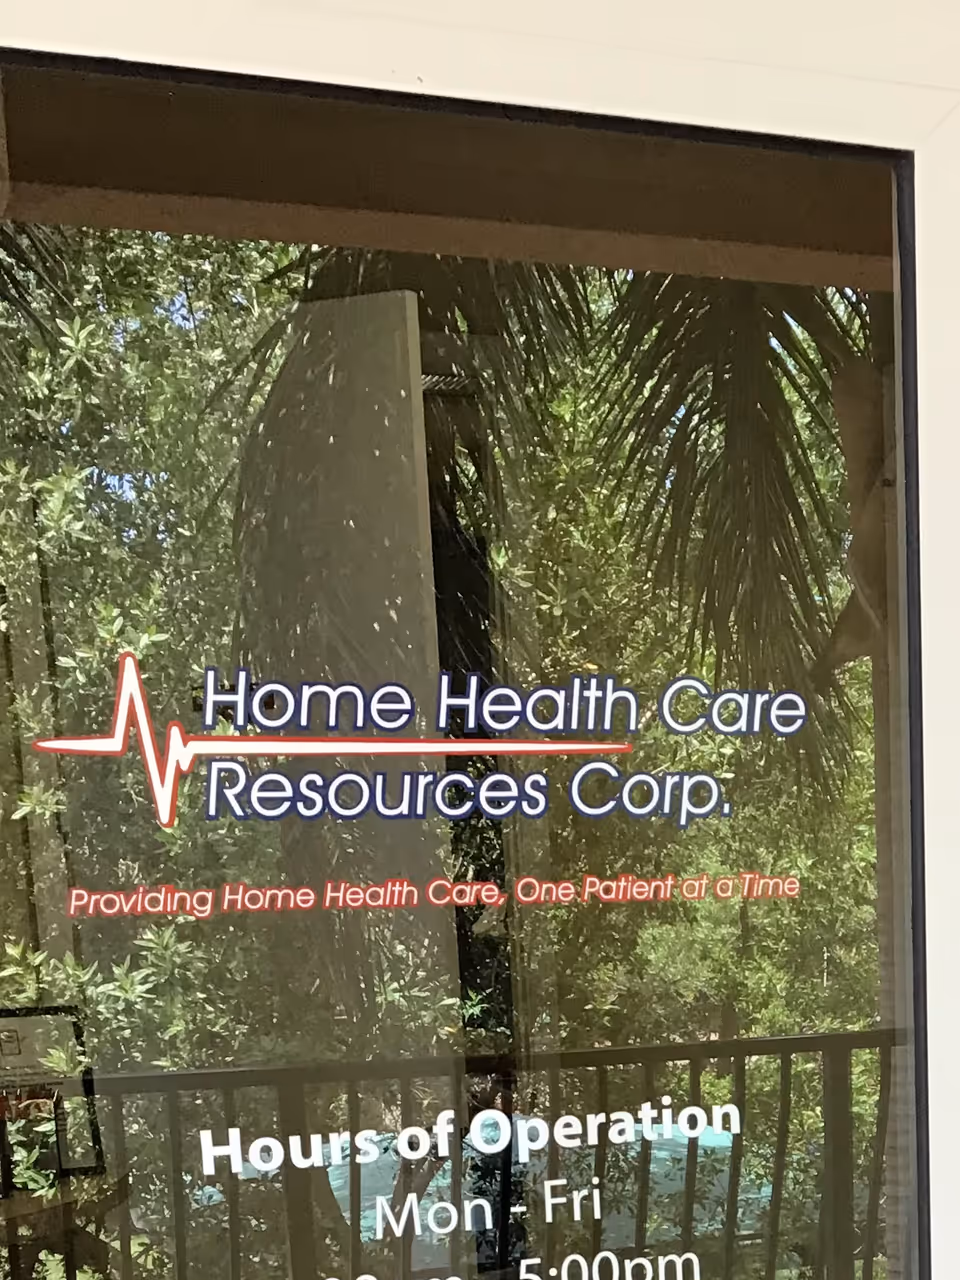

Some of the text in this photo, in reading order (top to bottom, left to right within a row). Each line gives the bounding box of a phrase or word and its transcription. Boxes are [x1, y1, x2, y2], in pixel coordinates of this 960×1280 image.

[204, 667, 808, 735] Home Health Care
[206, 758, 733, 829] Resources Corp.
[68, 872, 800, 918] Providing Home Health Care, One Patient at a Time
[199, 1095, 742, 1177] Hours of Operation
[374, 1178, 602, 1240] Mon - Fri
